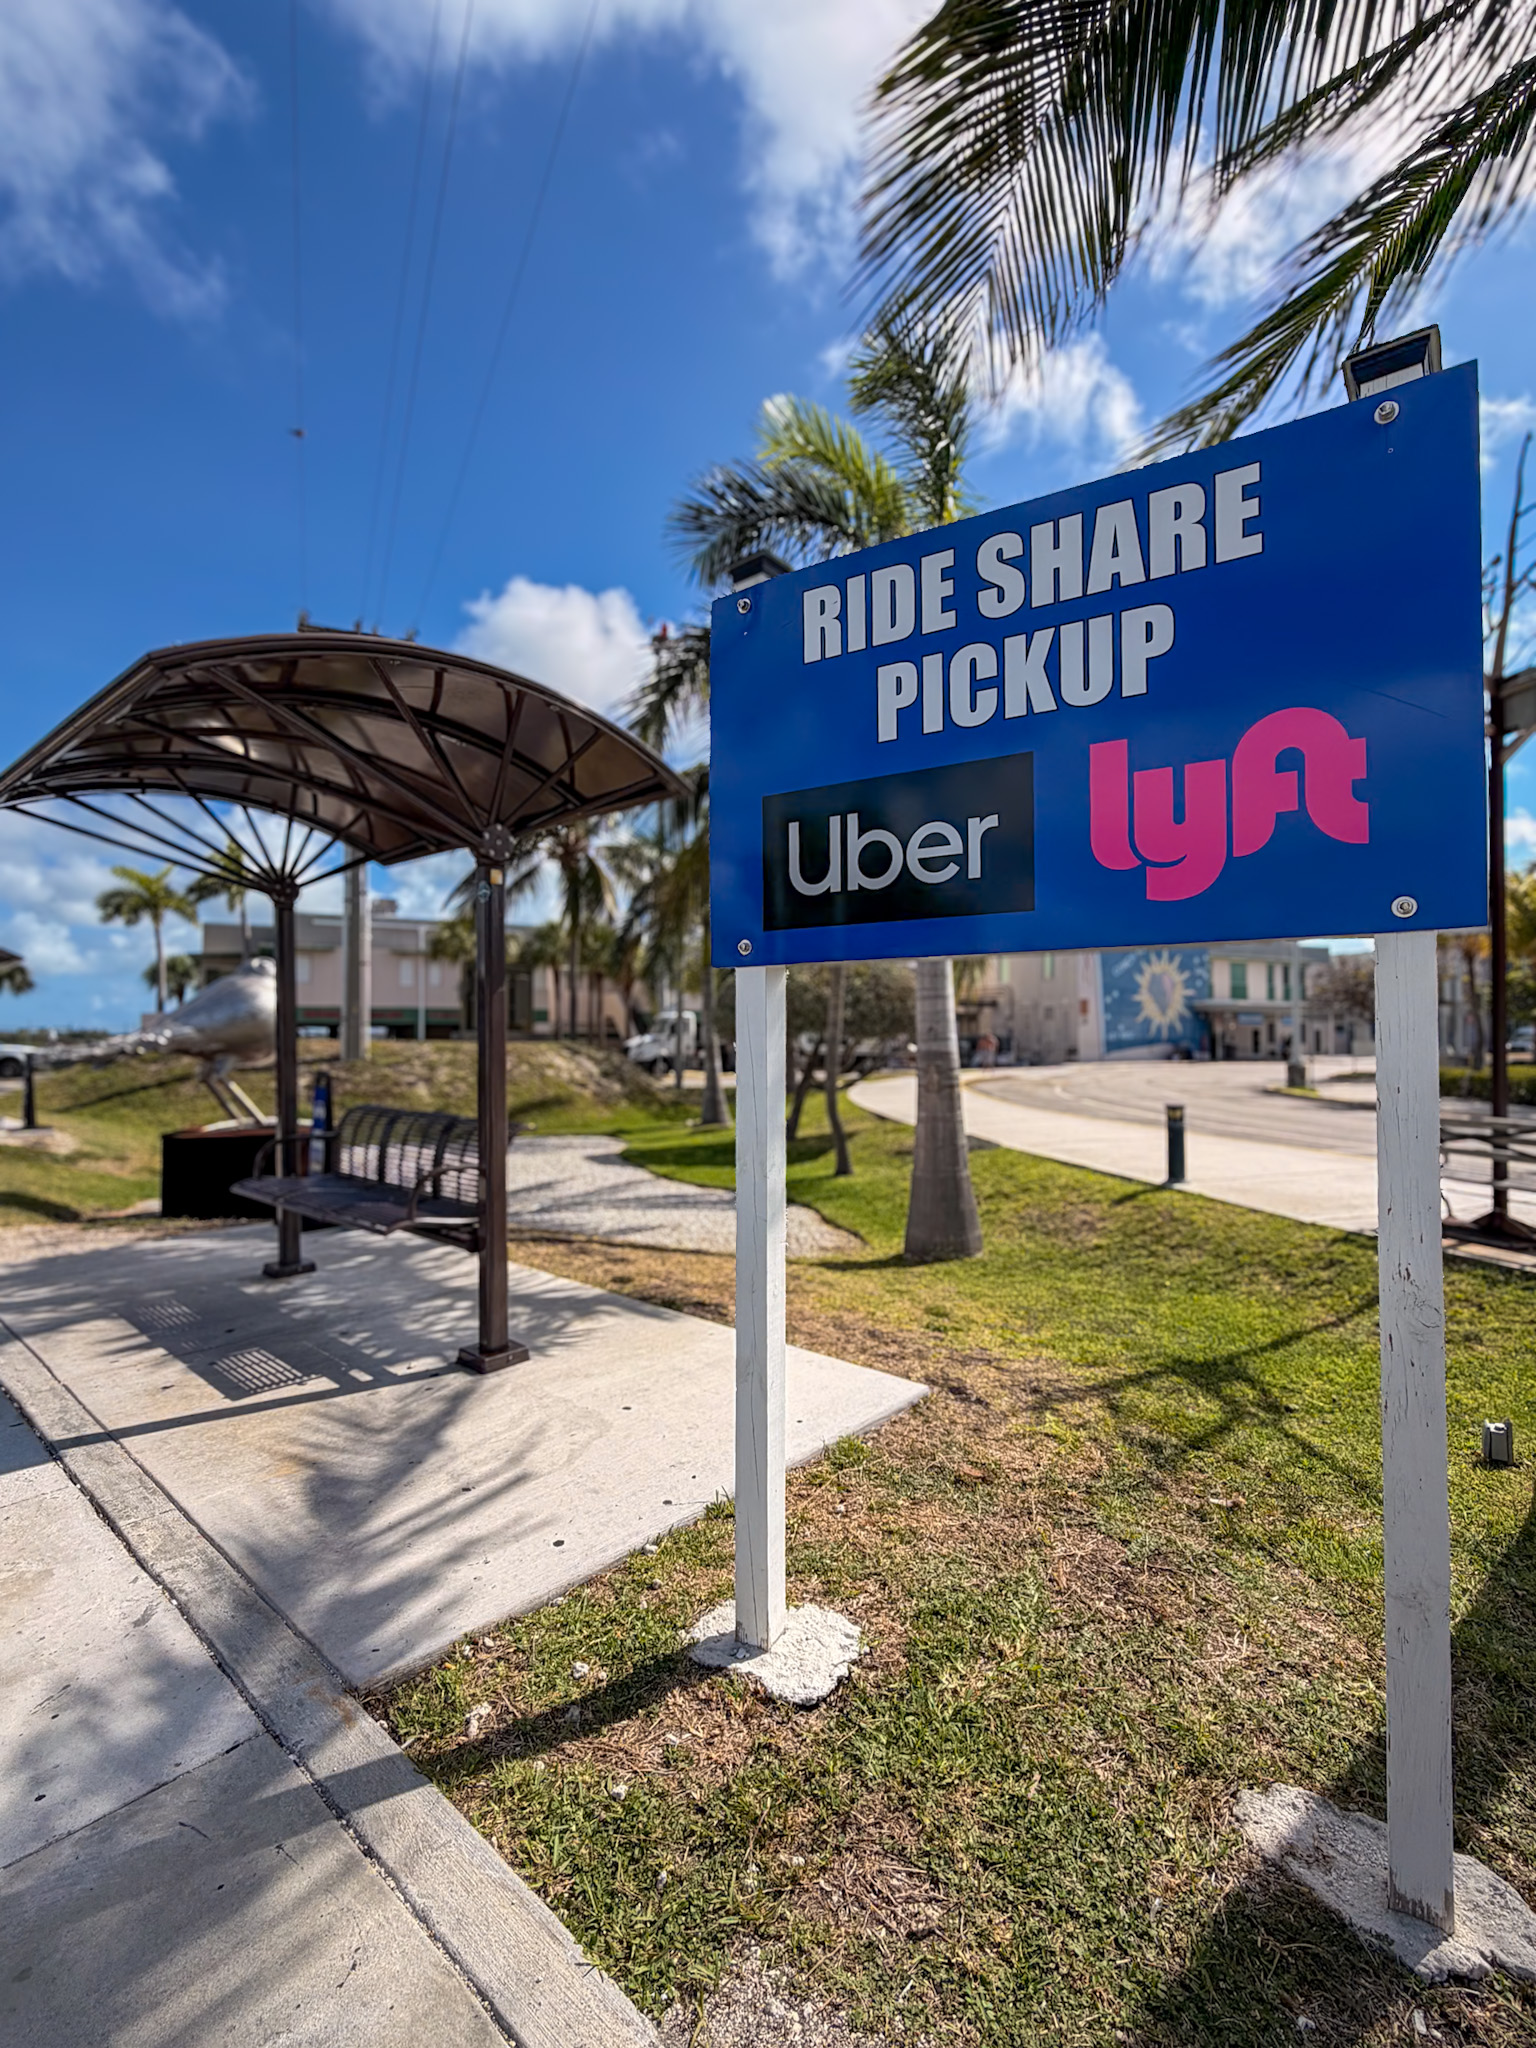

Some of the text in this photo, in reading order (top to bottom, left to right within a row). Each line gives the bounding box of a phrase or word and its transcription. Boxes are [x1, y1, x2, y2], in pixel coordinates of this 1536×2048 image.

[802, 460, 1264, 665] RIDE SHARE
[876, 603, 1176, 744] PICKUP
[787, 813, 999, 896] Uber
[1089, 706, 1369, 901] lyft
